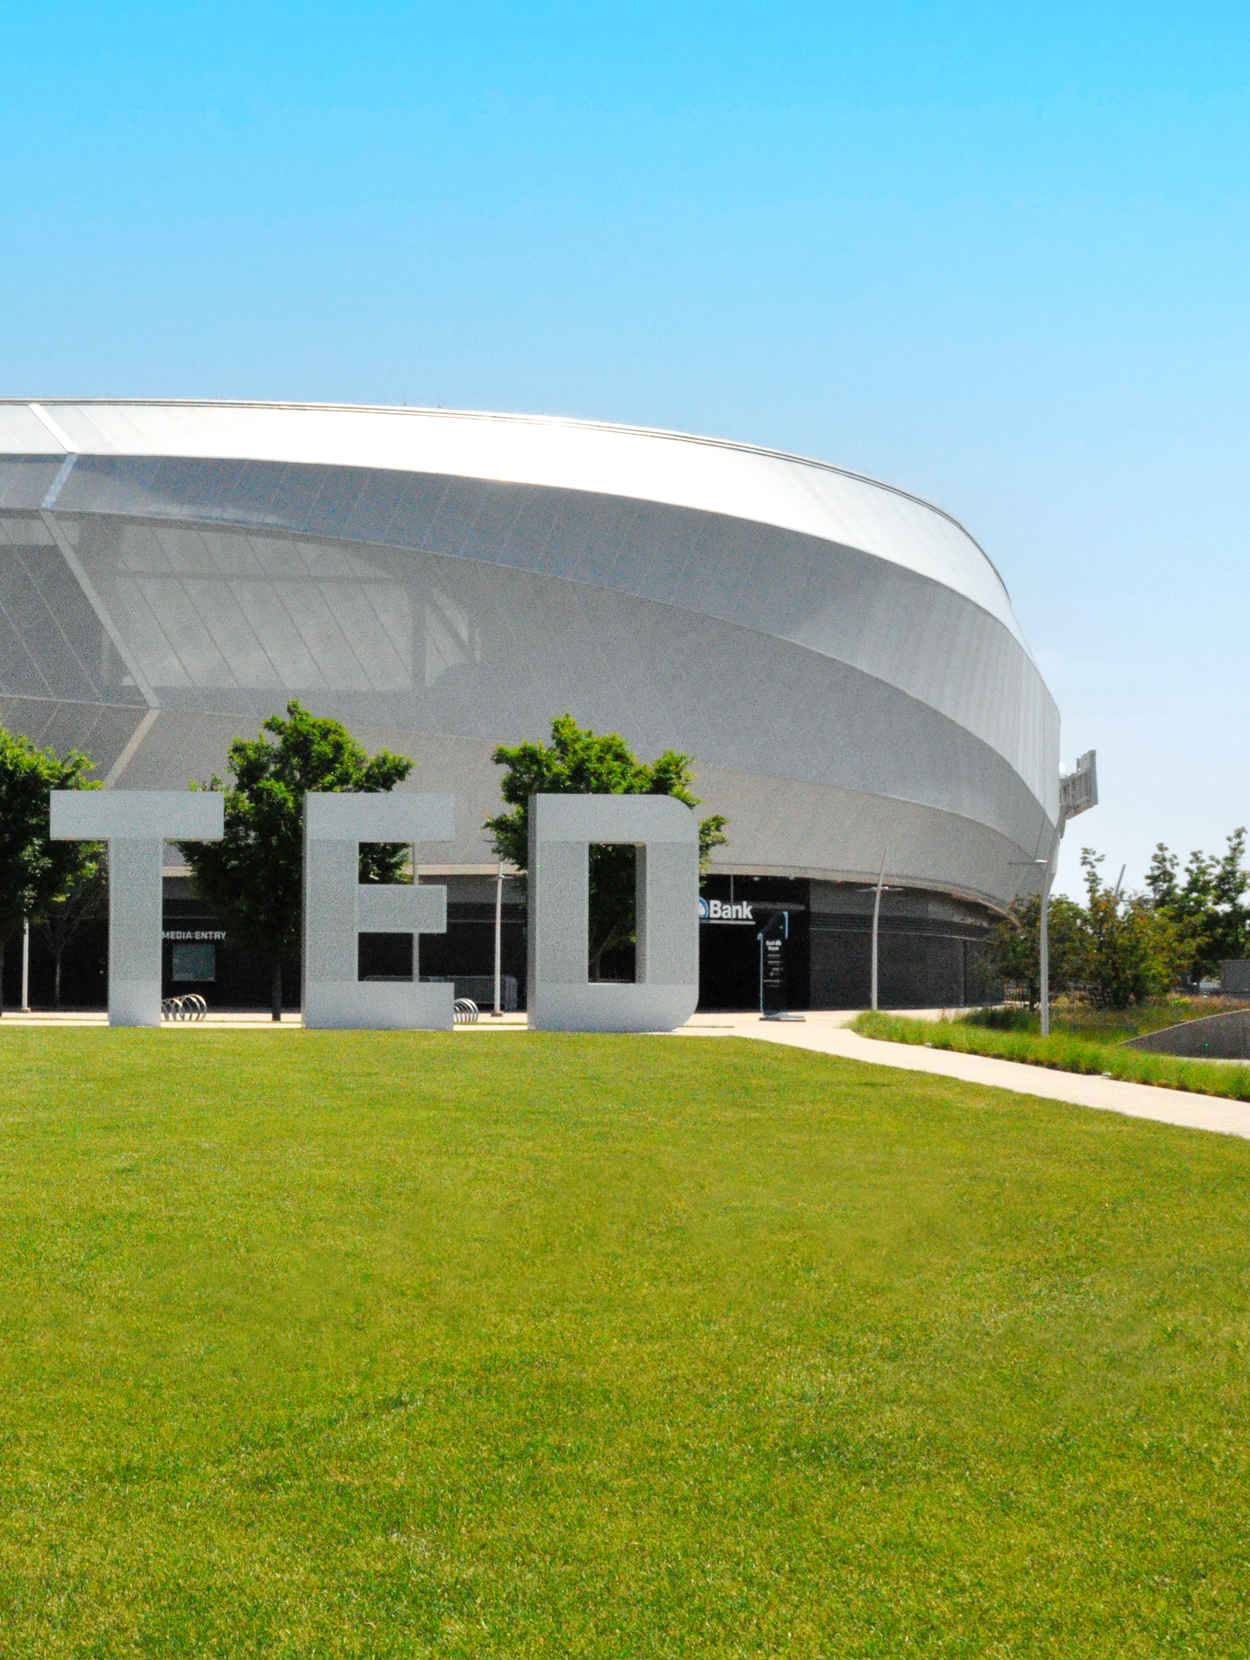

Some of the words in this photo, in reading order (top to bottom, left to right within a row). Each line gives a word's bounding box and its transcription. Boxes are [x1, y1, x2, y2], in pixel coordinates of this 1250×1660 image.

[710, 900, 753, 919] Bank
[162, 930, 192, 940] MEDIA
[195, 930, 227, 940] ENTRY
